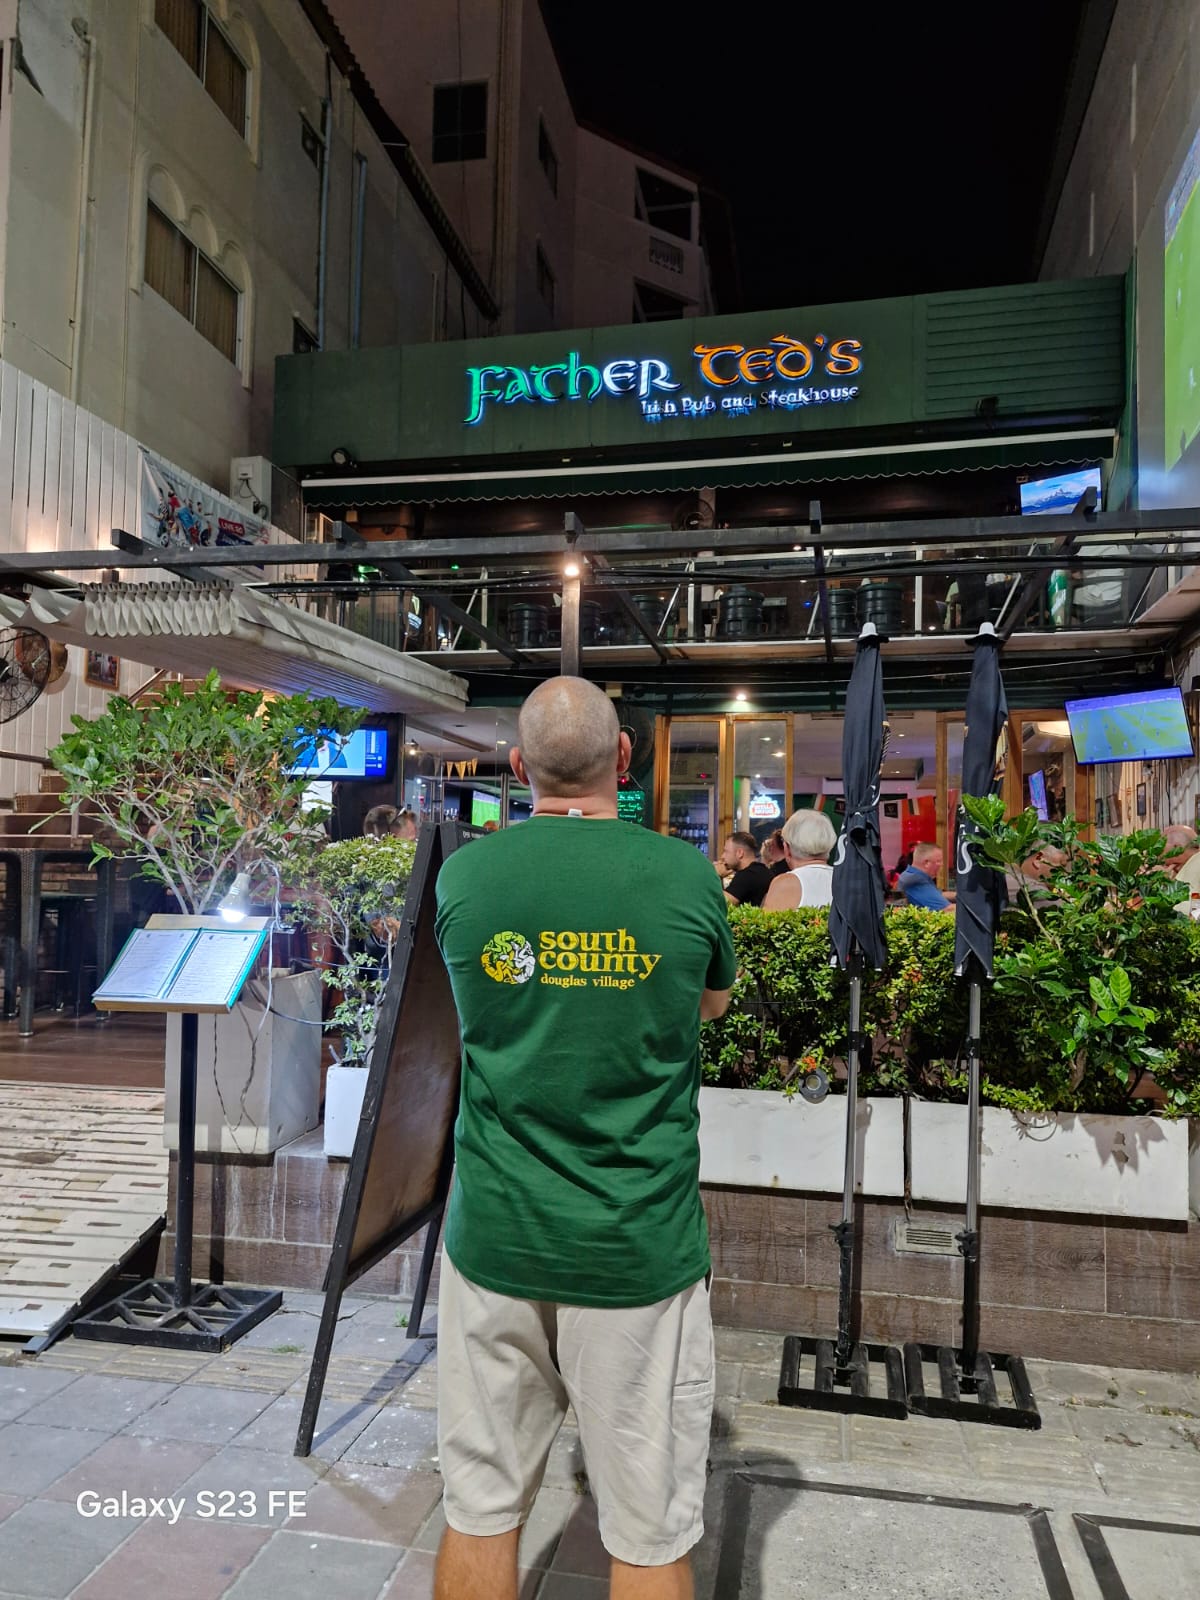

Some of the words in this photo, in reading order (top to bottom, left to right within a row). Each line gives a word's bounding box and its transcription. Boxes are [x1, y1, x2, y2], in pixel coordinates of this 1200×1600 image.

[640, 400, 678, 416] Irish
[681, 396, 716, 412] Pub
[721, 393, 754, 409] and
[759, 386, 859, 407] Steakhouse
[539, 929, 637, 953] south
[538, 951, 662, 980] county
[540, 974, 588, 988] douglas
[592, 976, 635, 989] village
